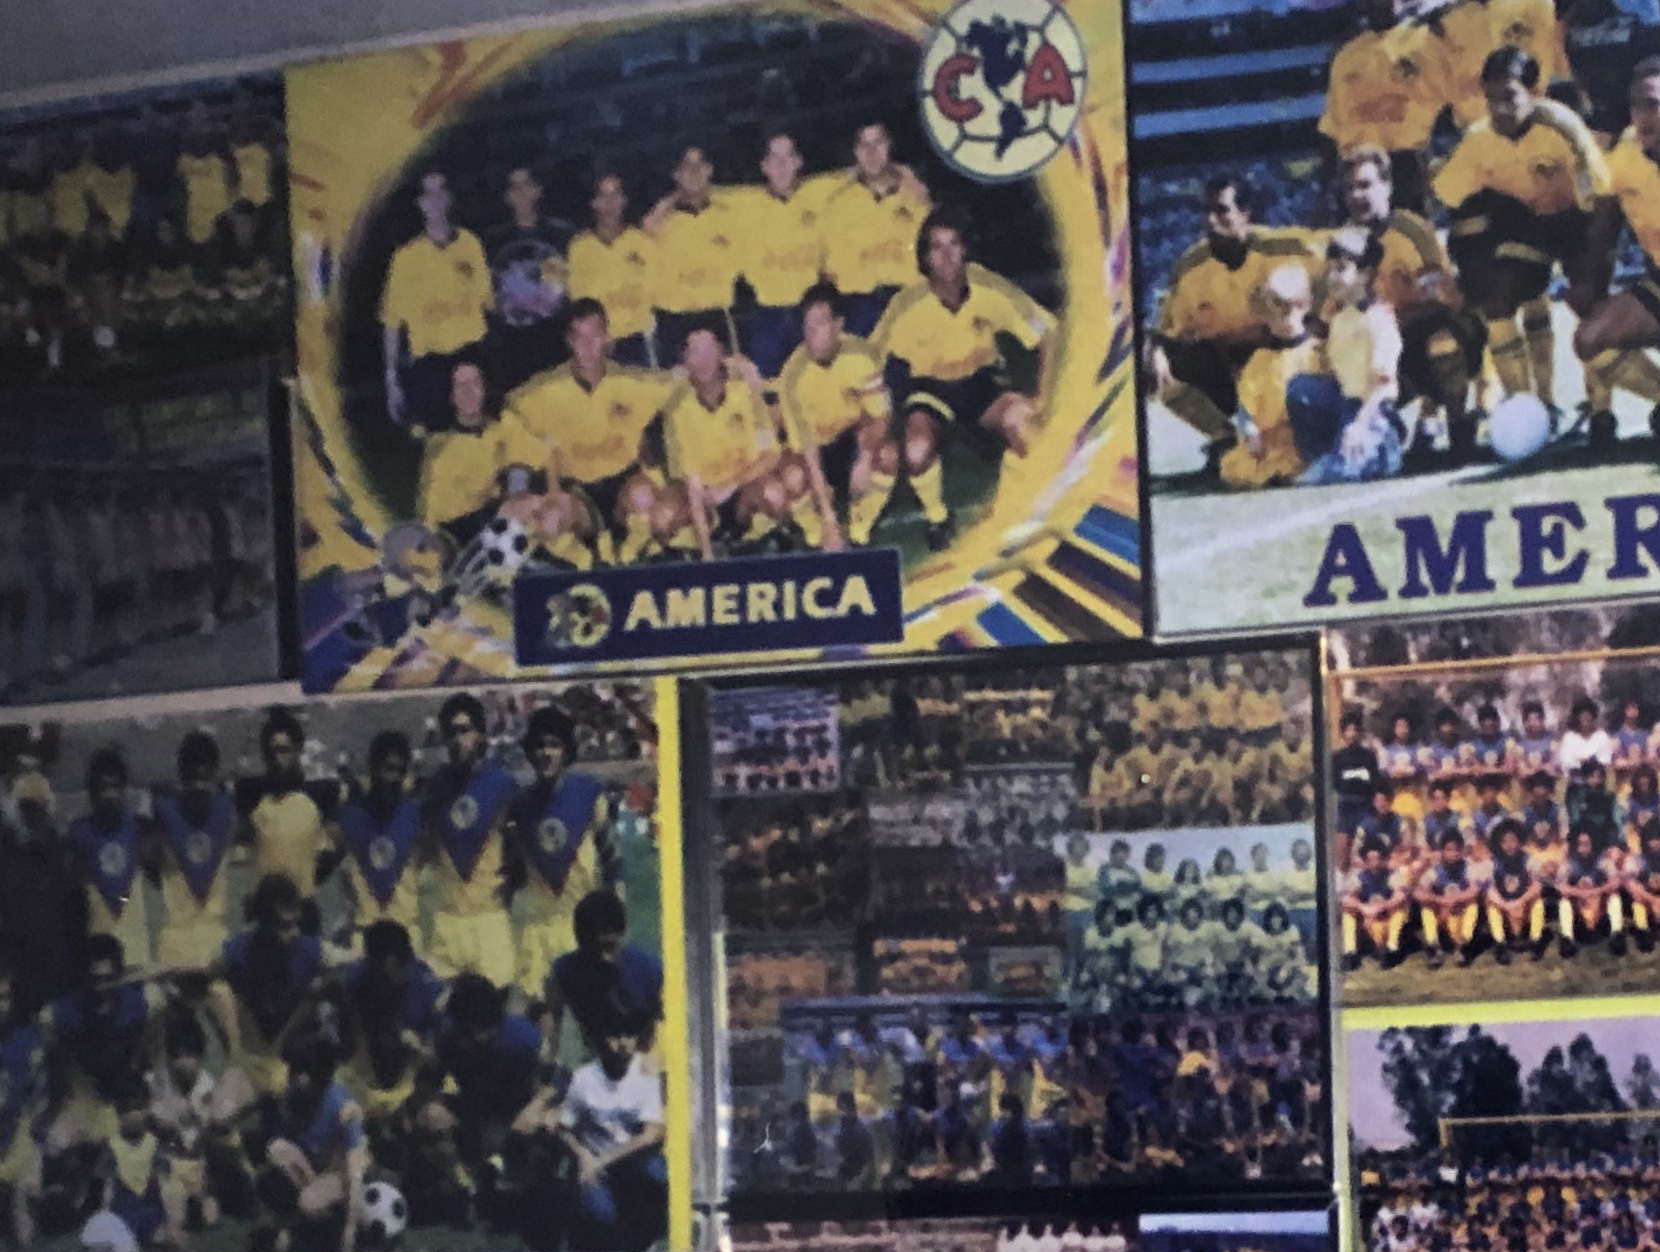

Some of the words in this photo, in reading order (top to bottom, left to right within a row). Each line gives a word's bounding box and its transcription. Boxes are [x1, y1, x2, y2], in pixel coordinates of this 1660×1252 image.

[933, 53, 984, 123] C
[1022, 42, 1075, 110] A
[624, 576, 877, 631] AMERICA
